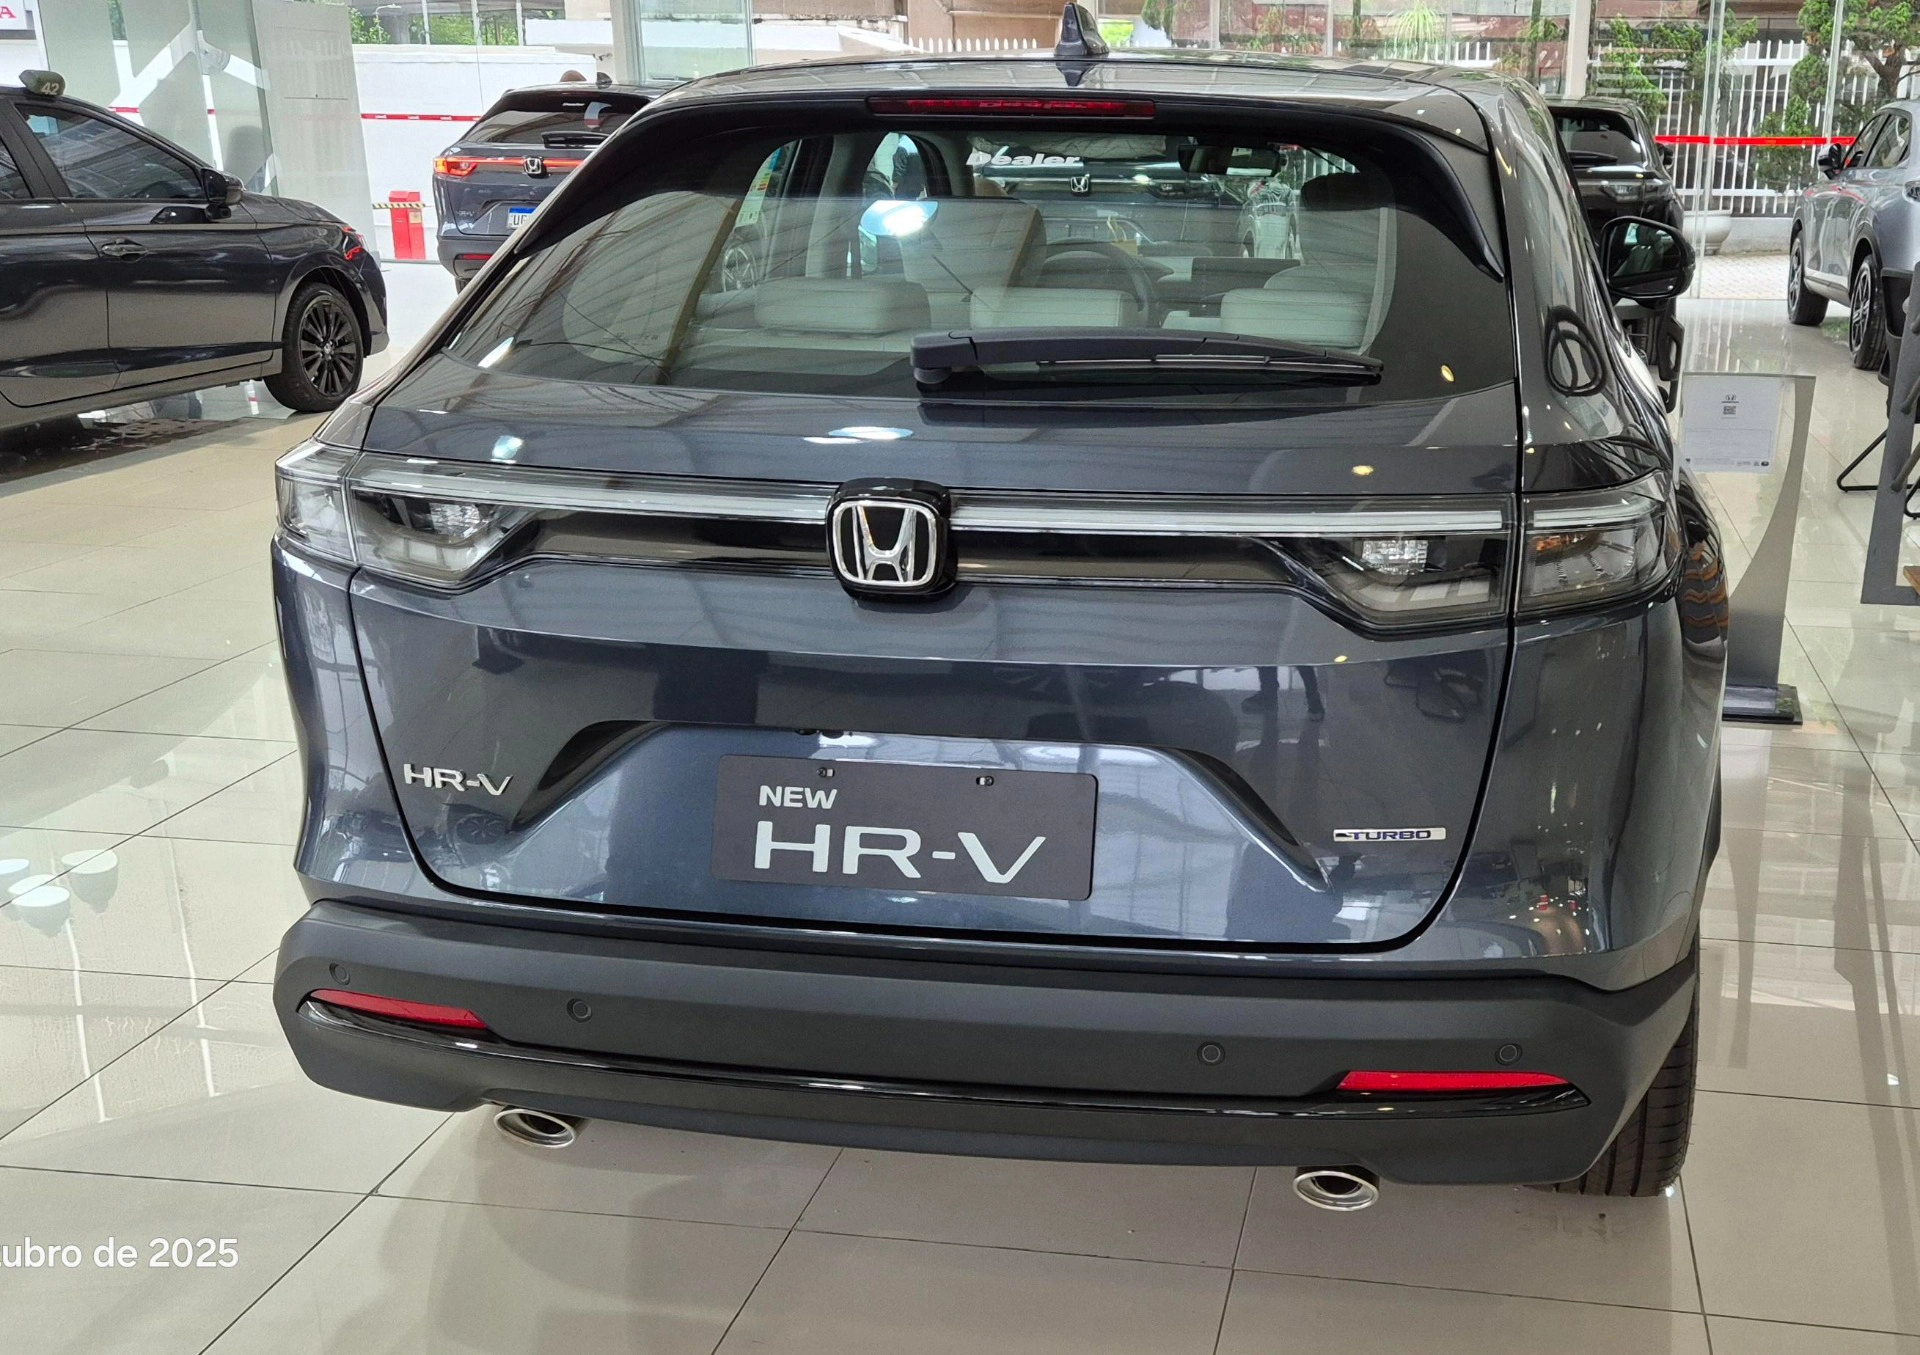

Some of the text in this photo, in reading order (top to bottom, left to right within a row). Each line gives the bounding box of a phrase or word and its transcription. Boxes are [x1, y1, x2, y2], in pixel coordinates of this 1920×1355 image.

[41, 82, 60, 95] 42
[966, 153, 1081, 166] Dealer
[403, 763, 513, 796] HR-V
[758, 785, 838, 810] NEW
[1347, 830, 1432, 840] TURBO
[754, 820, 1046, 884] HR-V
